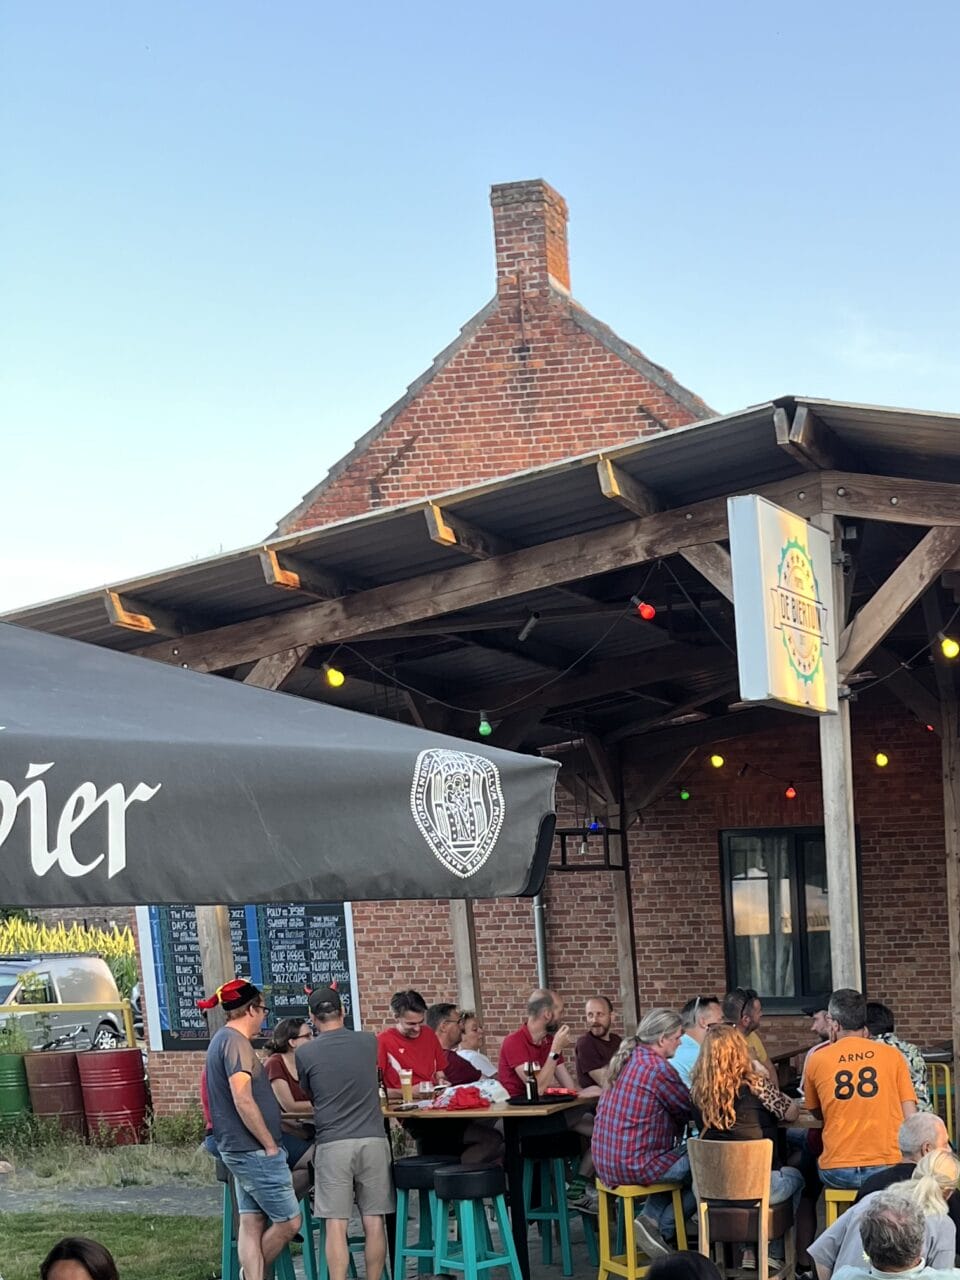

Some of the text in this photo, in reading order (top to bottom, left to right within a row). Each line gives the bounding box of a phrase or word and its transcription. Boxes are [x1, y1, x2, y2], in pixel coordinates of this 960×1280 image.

[780, 592, 791, 621] DE
[178, 976, 198, 986] LUDO
[838, 1050, 875, 1064] ARNO
[834, 1066, 879, 1101] 88
